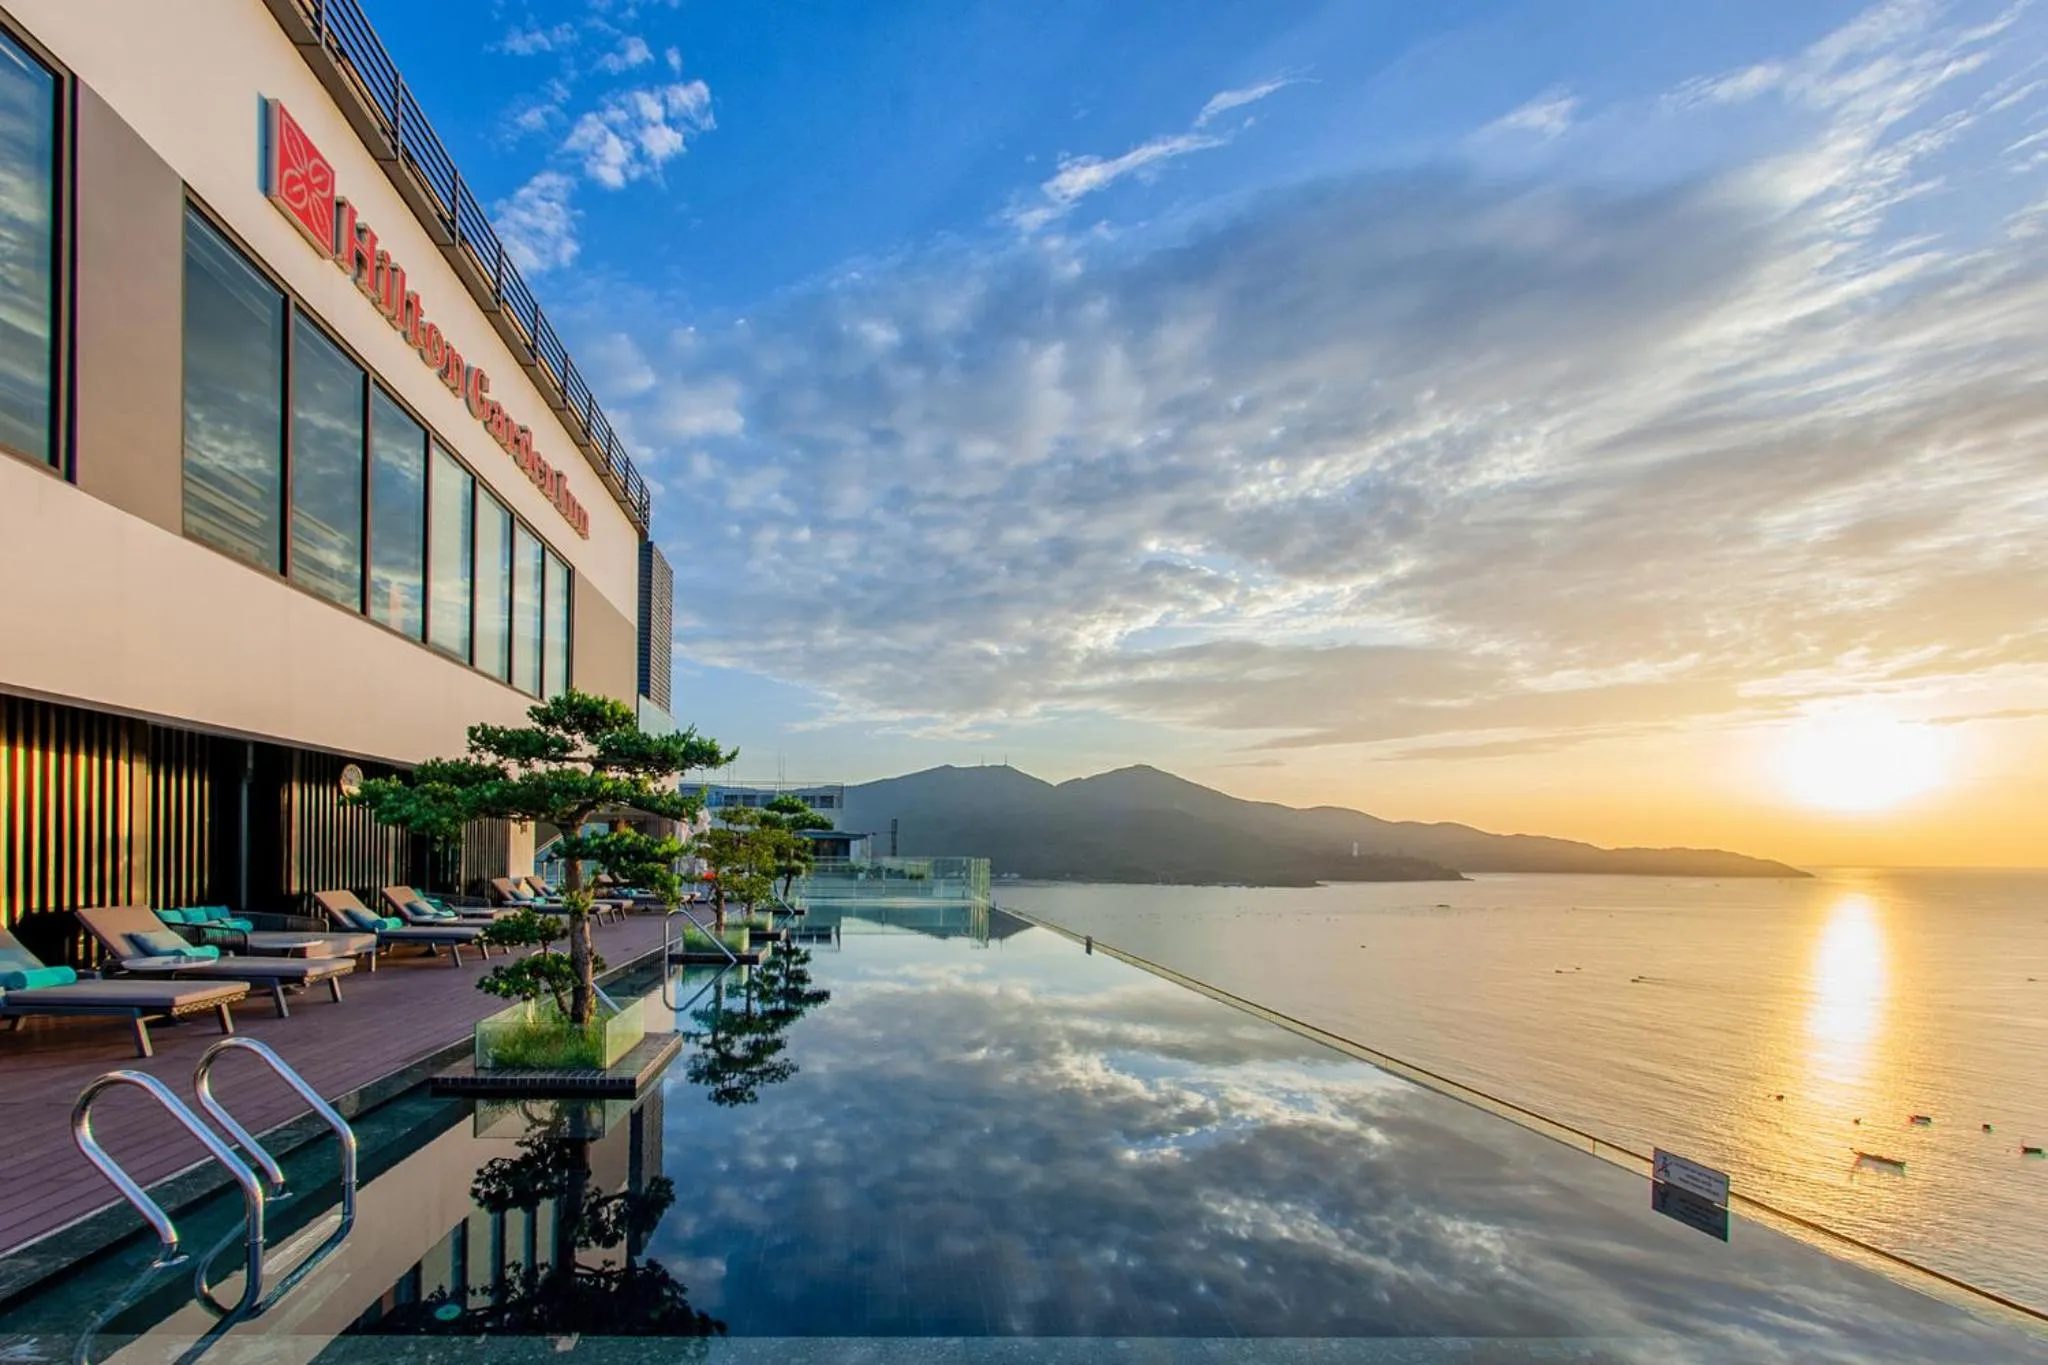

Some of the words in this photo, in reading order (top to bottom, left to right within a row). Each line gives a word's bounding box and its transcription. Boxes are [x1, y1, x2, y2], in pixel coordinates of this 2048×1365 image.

[335, 196, 465, 399] Hilton
[465, 366, 557, 502] Garden
[553, 470, 589, 541] Inn
